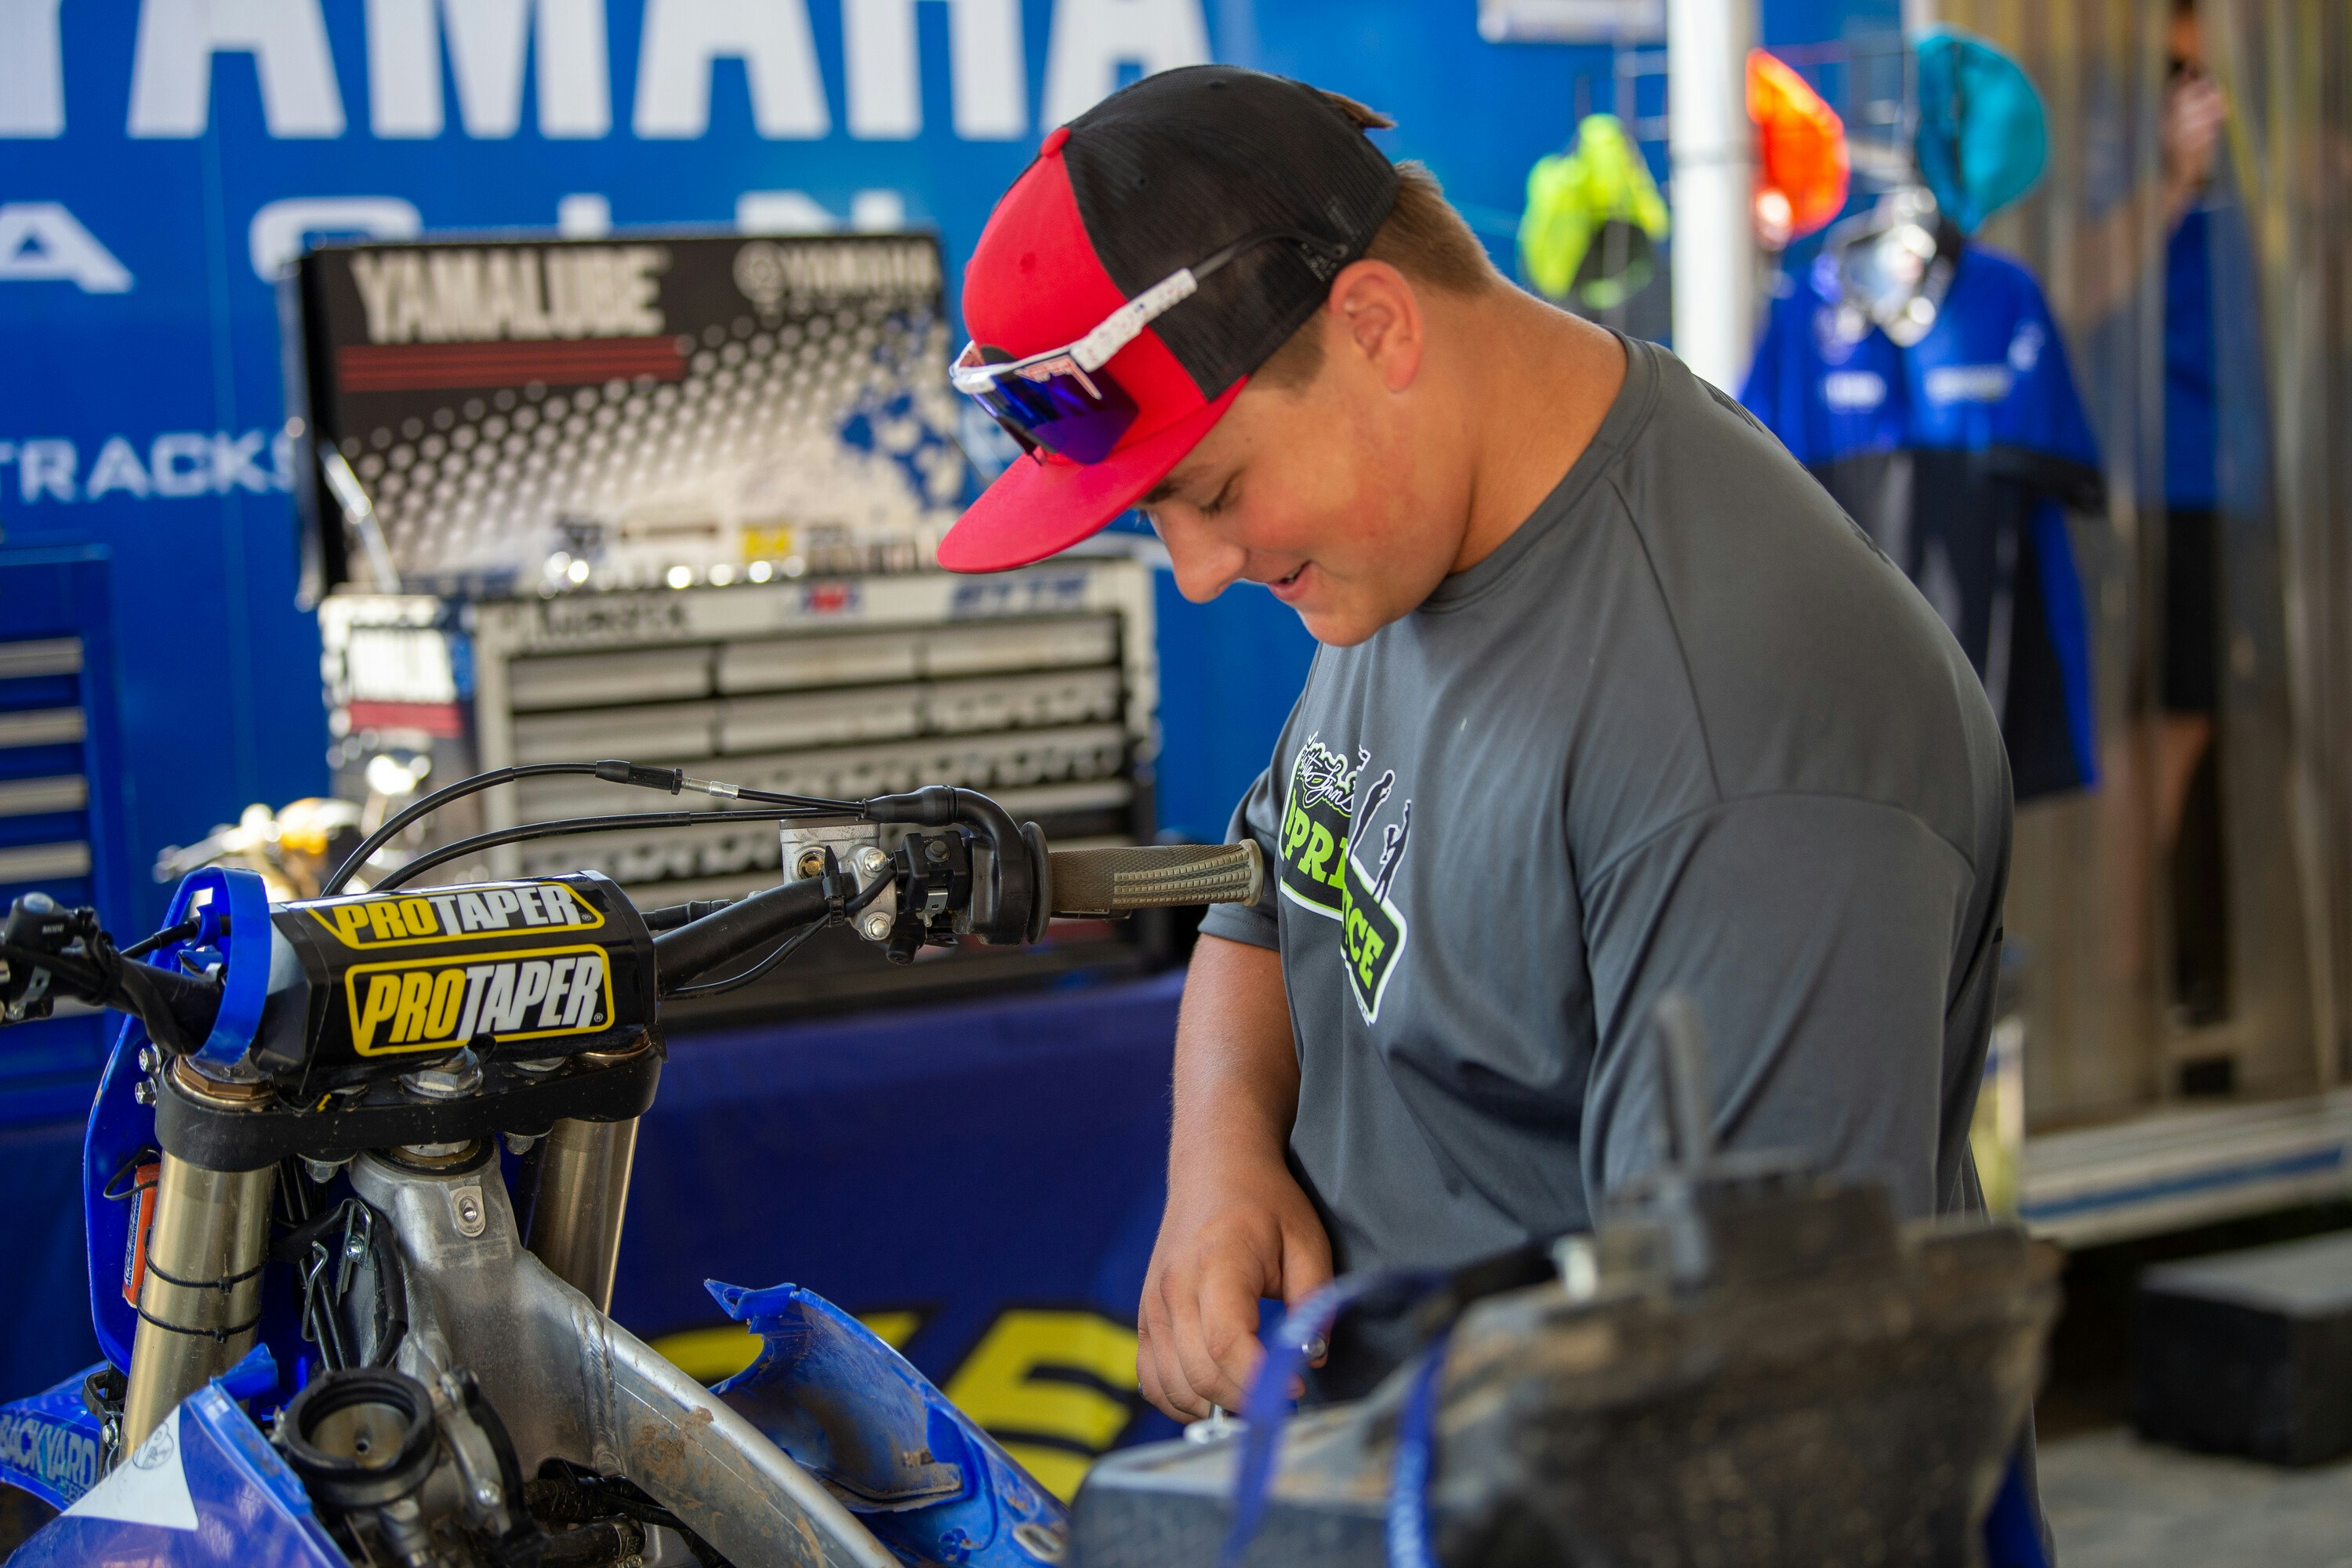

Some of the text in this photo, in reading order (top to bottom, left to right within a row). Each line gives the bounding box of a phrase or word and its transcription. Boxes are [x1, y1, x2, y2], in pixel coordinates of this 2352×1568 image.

[0, 433, 298, 504] RACK
[42, 924, 64, 934] MODE
[332, 884, 582, 944] PROTAPER
[359, 956, 604, 1050] PROTAPER
[0, 1414, 96, 1490] BACKYARD
